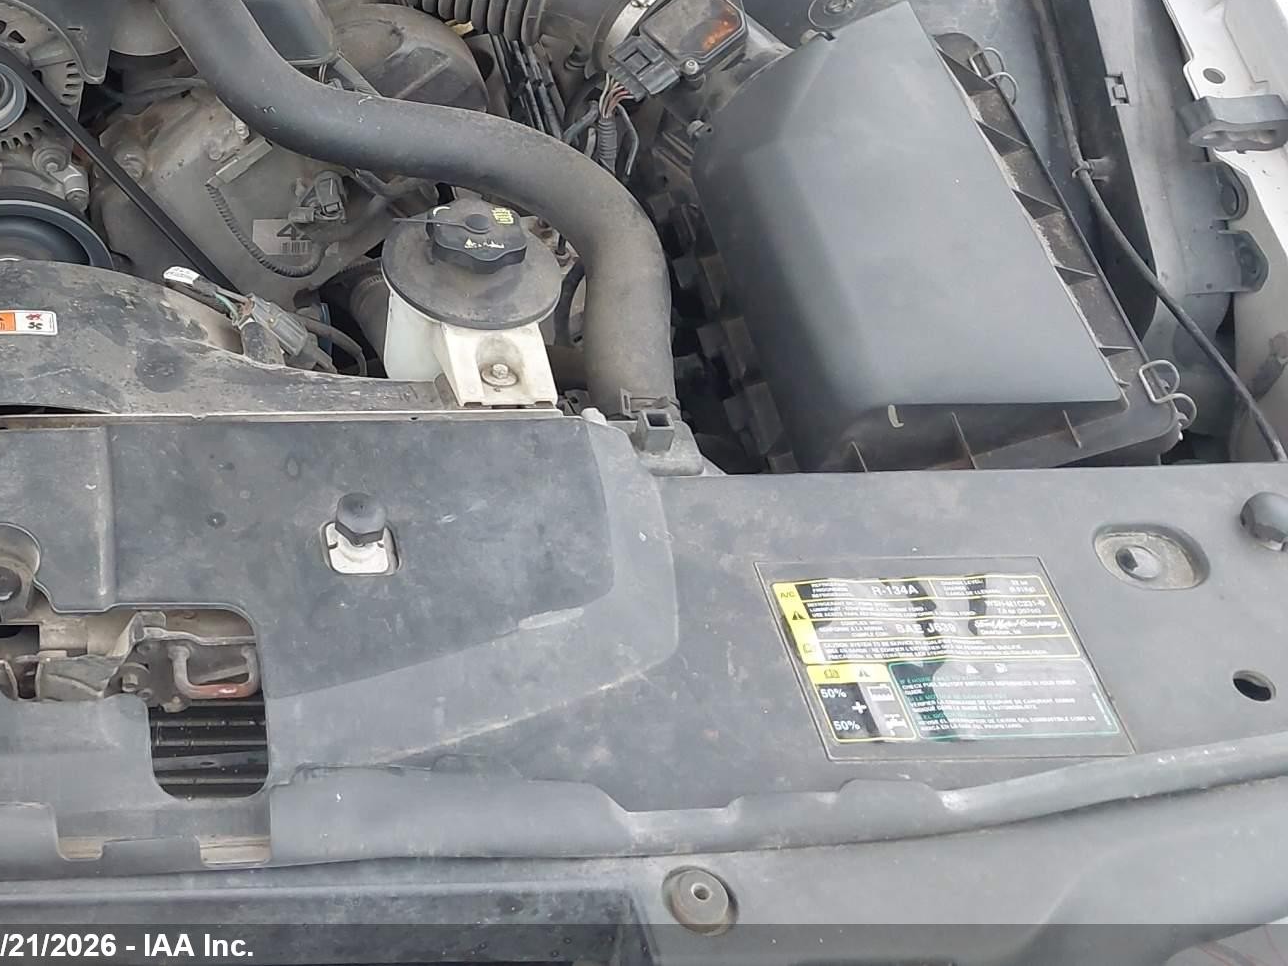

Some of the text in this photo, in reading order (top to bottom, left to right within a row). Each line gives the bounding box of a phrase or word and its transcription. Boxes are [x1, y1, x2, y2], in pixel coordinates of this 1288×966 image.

[780, 591, 795, 599] A/C
[871, 584, 919, 597] R-134A
[820, 687, 847, 699] 50%
[833, 719, 860, 731] 50%
